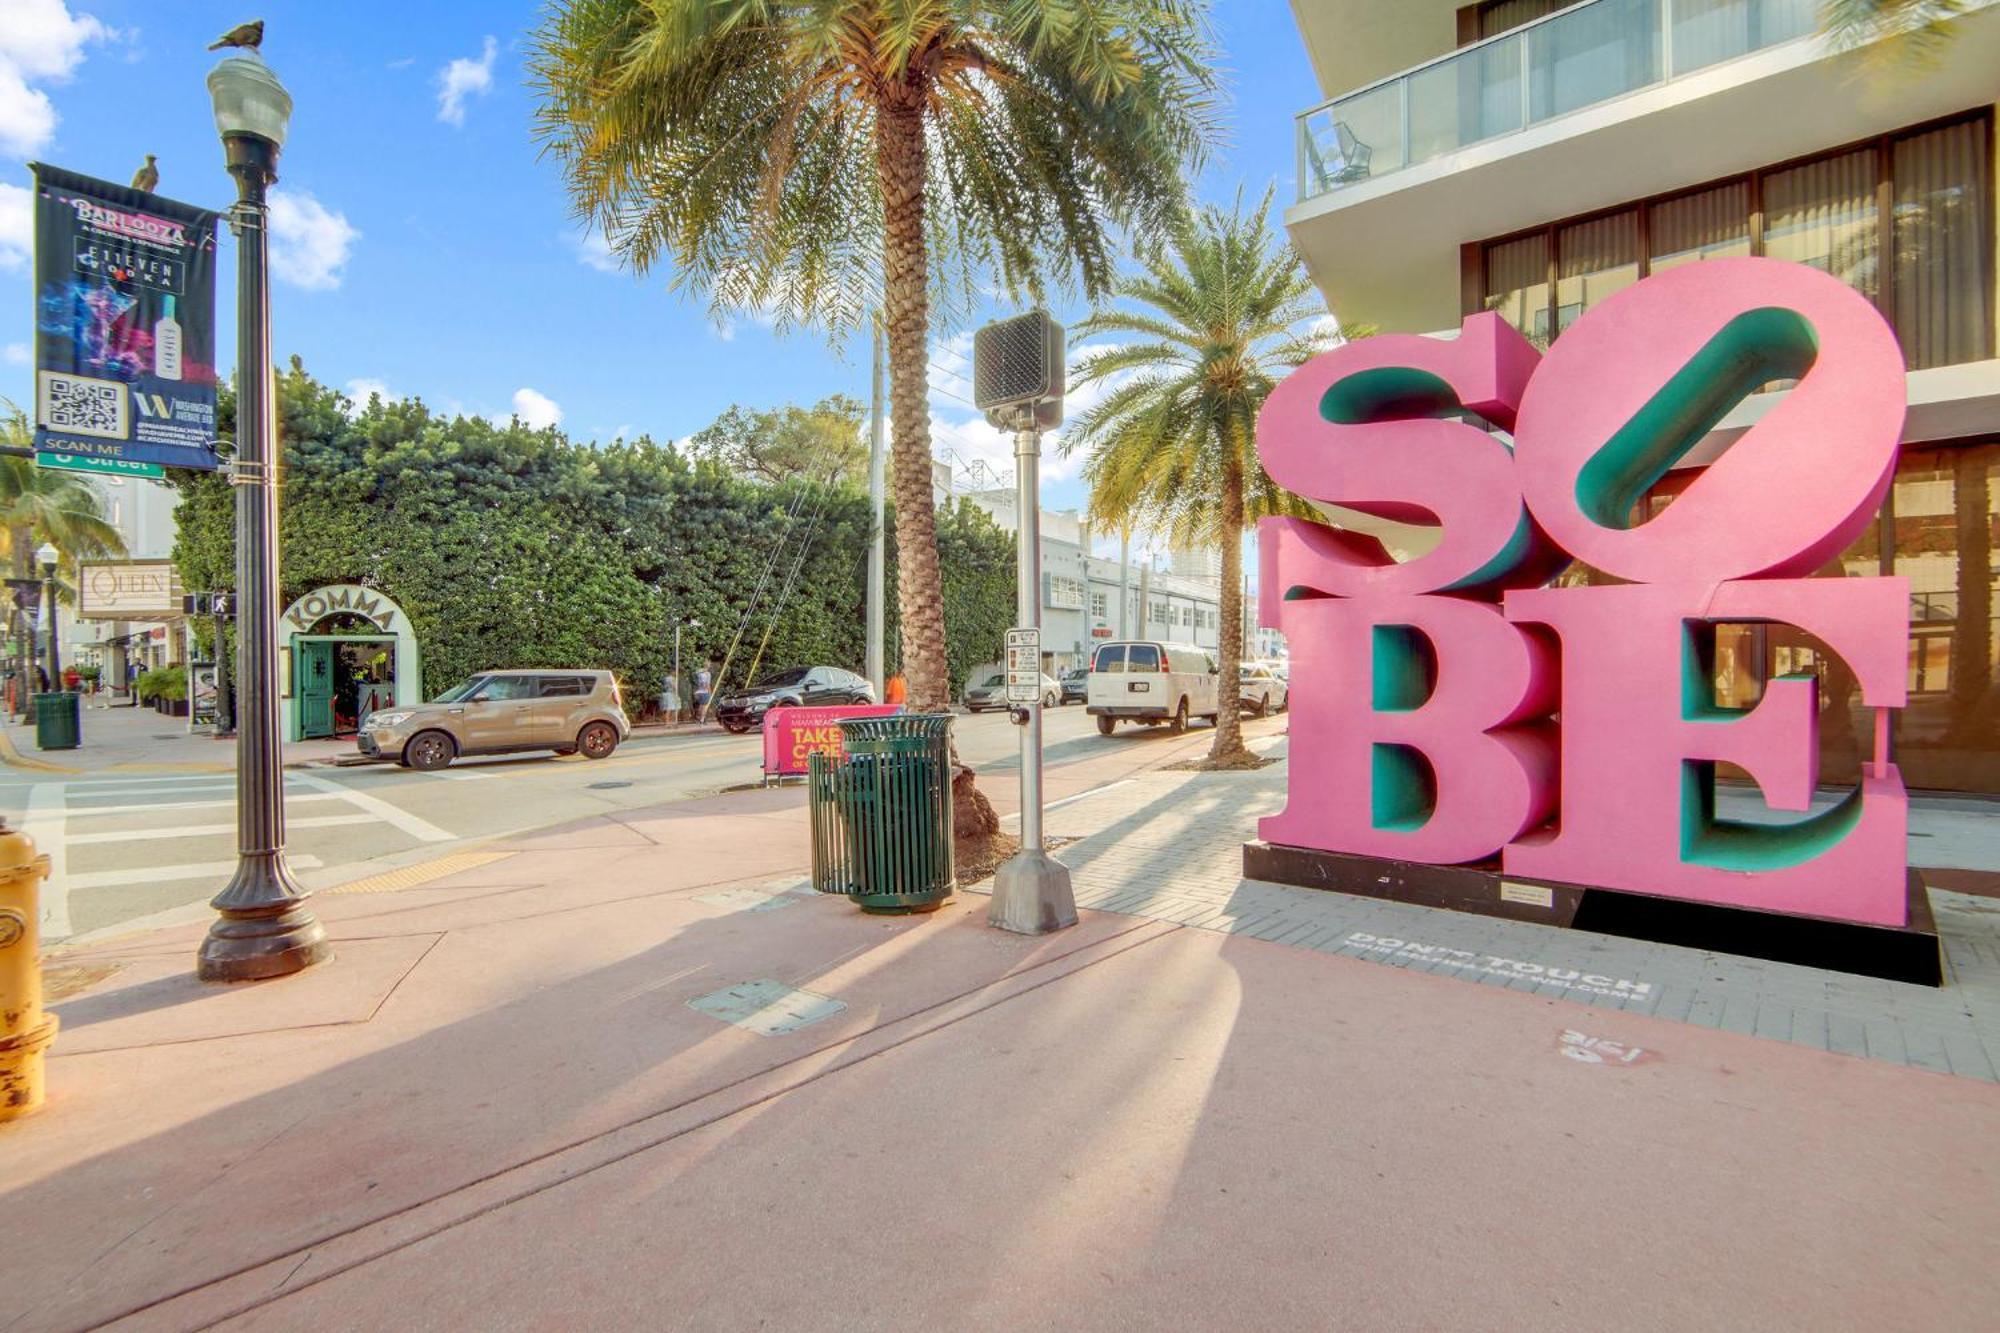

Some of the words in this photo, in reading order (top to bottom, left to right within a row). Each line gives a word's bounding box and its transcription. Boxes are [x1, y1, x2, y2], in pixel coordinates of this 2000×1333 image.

[45, 438, 93, 452] SCAN
[97, 444, 124, 456] ME
[1256, 256, 1908, 600] SO
[91, 570, 164, 606] QUEEN
[791, 727, 842, 743] TAKE
[1258, 577, 1909, 925] BE
[1348, 931, 1477, 958] DON'T
[1486, 954, 1652, 994] TOUCH
